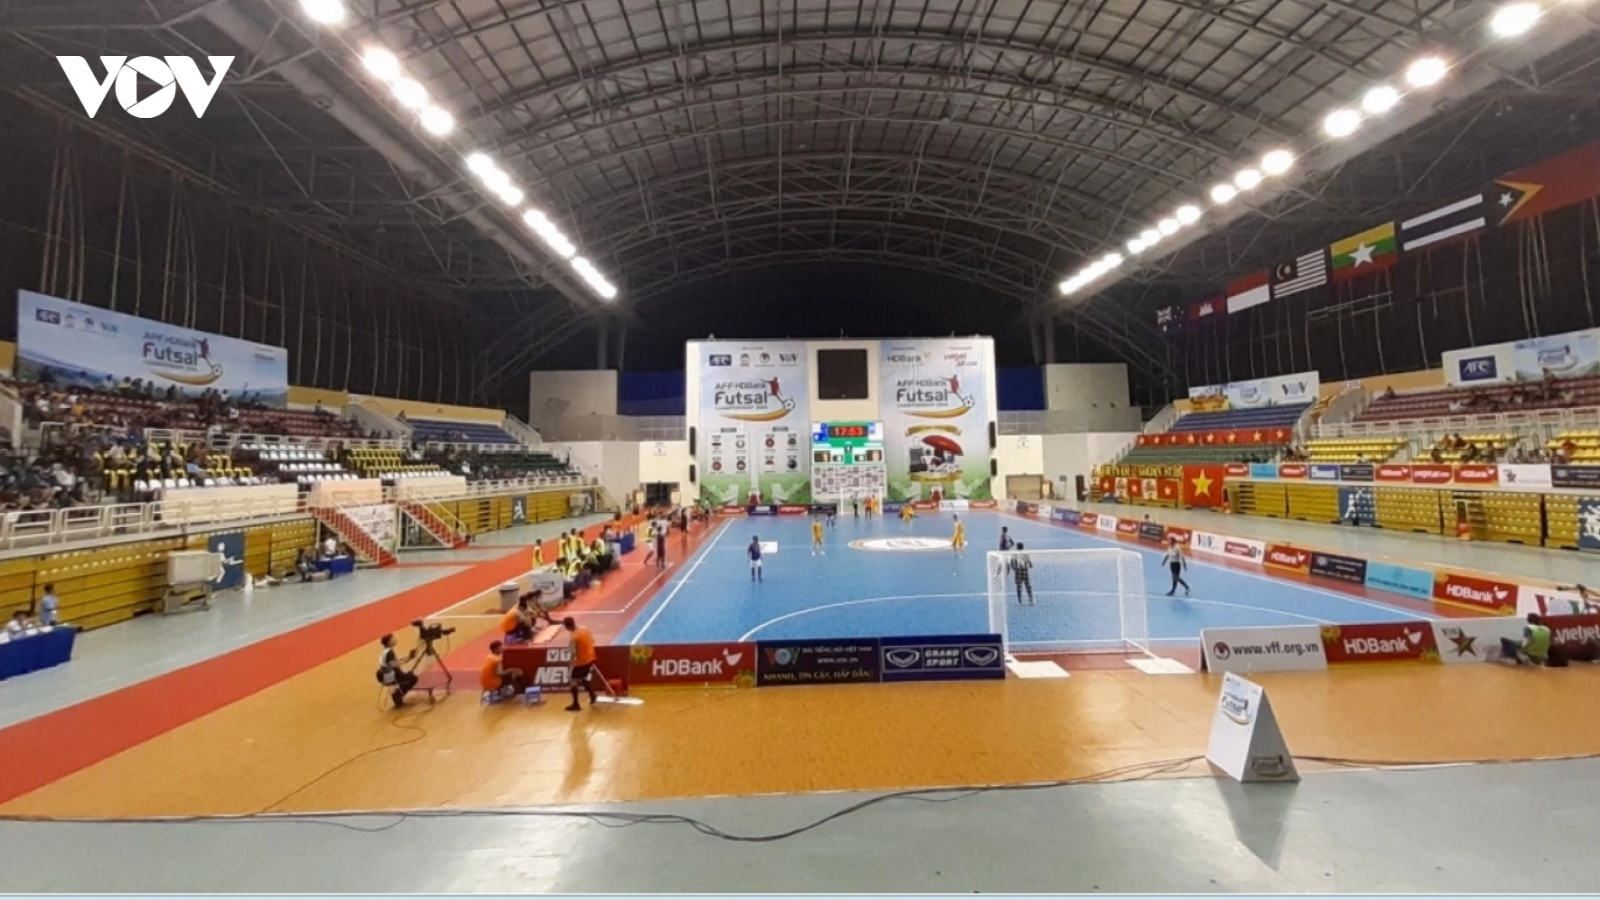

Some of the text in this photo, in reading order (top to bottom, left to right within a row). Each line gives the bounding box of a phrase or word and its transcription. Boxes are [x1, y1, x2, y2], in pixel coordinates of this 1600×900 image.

[143, 341, 198, 366] Futsal
[887, 354, 922, 363] HDBank
[1463, 360, 1490, 374] AFC
[715, 390, 768, 406] Futsal
[896, 388, 949, 403] Futsal
[834, 427, 864, 437] 17:53
[1446, 583, 1494, 603] HDBank
[1232, 640, 1319, 656] www.vff.org.vn
[1343, 636, 1410, 655] HDBank
[764, 647, 801, 666] VOV
[925, 649, 960, 658] GRAND
[652, 658, 723, 676] HDBank
[925, 658, 960, 667] SPORT
[799, 671, 812, 679] TIN
